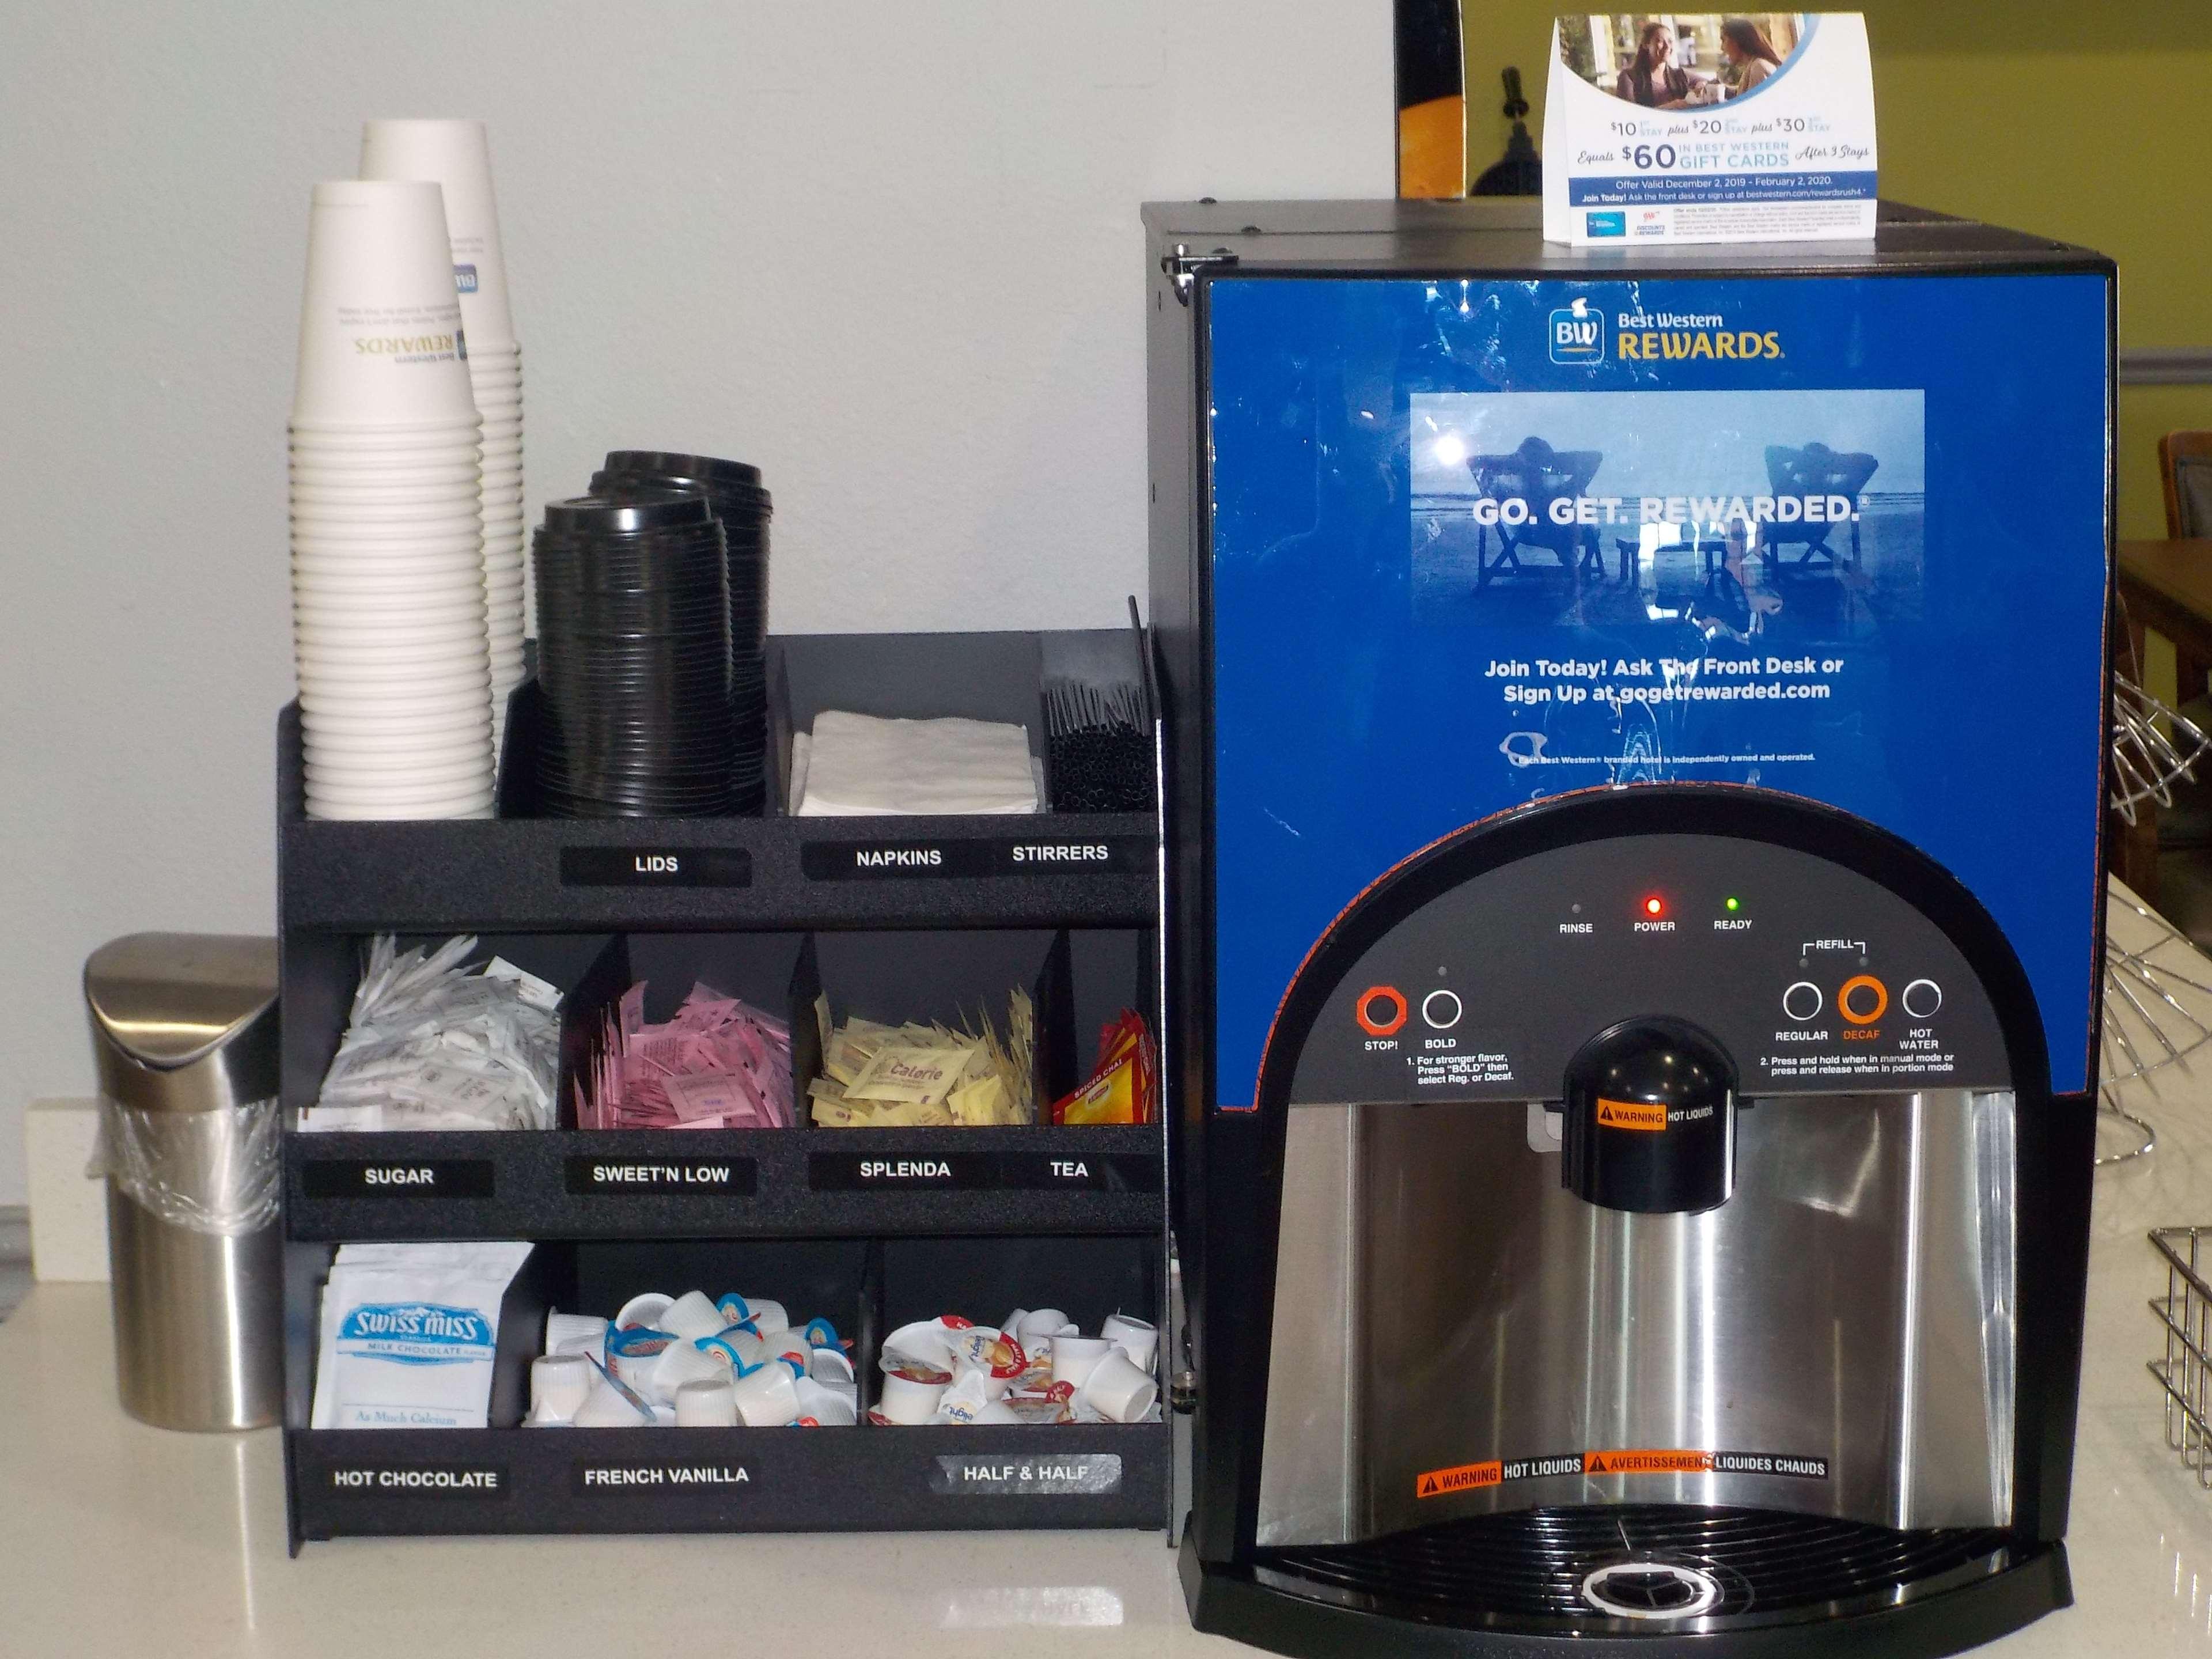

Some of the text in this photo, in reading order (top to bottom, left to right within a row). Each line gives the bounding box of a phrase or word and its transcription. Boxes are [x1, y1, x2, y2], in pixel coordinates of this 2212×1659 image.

[1611, 122, 1637, 136] $10
[1668, 124, 1689, 137] plus
[1692, 120, 1722, 134] $20
[1751, 122, 1772, 135] plus
[1776, 118, 1805, 132] $30
[1679, 142, 1789, 153] IN BEST WESTERN
[1796, 146, 1827, 160] After
[1838, 144, 1869, 160] Stays
[1578, 144, 1676, 169] Equals $60
[1680, 154, 1789, 169] GIFT CARDS
[1616, 181, 1639, 190] Offer
[1642, 180, 1664, 190] Valid
[1666, 179, 1711, 189] December
[1714, 179, 1722, 188] 2,
[1725, 178, 1746, 187] 2019
[1755, 177, 1796, 187] February
[1798, 177, 1806, 186] 2,
[1582, 194, 1599, 202] Join
[1601, 194, 1627, 203] Today!
[1628, 193, 1642, 201] Ask
[1658, 192, 1677, 200] front
[1679, 191, 1695, 200] desk
[1707, 191, 1724, 201] sign
[1618, 313, 1724, 328] Best Western
[1556, 321, 1598, 345] BW
[1472, 498, 1538, 525] GO.
[1548, 497, 1628, 524] GET.
[1484, 657, 1844, 679] Join Today! Ask The Front Desk or
[1503, 682, 1830, 705] Sign Up at gogetrewarded.com
[1540, 756, 1560, 764] Best
[1604, 755, 1638, 764] branded
[1640, 755, 1662, 764] hotel
[1664, 755, 1671, 764] is
[1672, 754, 1729, 764] independently
[1731, 754, 1758, 762] owned
[1760, 753, 1775, 762] and
[1777, 753, 1816, 763] operated.
[857, 849, 942, 867] NAPKINS
[1012, 844, 1108, 862] STIRRERS
[635, 856, 678, 872] LIDS
[1559, 923, 1593, 934] RINSE
[1634, 922, 1675, 931] POWER
[1714, 919, 1752, 930] READY
[1816, 940, 1854, 949] REFILL
[1775, 1031, 1829, 1041] REGULAR
[1843, 1029, 1881, 1040] DECAF
[1909, 1028, 1933, 1038] HOT
[1364, 1040, 1399, 1051] STOP!
[1425, 1039, 1457, 1049] BOLD
[1899, 1039, 1939, 1050] WATER
[1406, 1053, 1508, 1066] 1. For stronger flavor,
[1760, 1058, 1768, 1066] 2.
[1771, 1056, 1798, 1066] Press
[1800, 1056, 1817, 1065] and
[1820, 1055, 1840, 1064] hold
[1842, 1055, 1867, 1064] when
[1869, 1055, 1877, 1063] in
[1880, 1054, 1914, 1063] manual
[1916, 1053, 1942, 1062] mode
[891, 1062, 944, 1081] Calorie
[1418, 1066, 1445, 1075] Press
[1487, 1062, 1509, 1071] then
[1771, 1063, 1954, 1077] press and release when in portion mode
[1074, 1077, 1101, 1099] SPICED
[1103, 1058, 1123, 1078] CHAI
[1418, 1075, 1446, 1085] select
[1448, 1074, 1469, 1085] Reg.
[1484, 1071, 1514, 1082] Decaf.
[1615, 1105, 1713, 1123] WARNING HOT LIQUIDS
[365, 1168, 435, 1184] SUGAR
[685, 1166, 729, 1183] LOW
[860, 1162, 951, 1177] SPLENDA
[1051, 1161, 1088, 1177] TEA
[367, 1342, 393, 1351] MILK
[397, 1344, 461, 1355] CHOCOLATE
[334, 1471, 497, 1487] HOT CHOCOLATE
[585, 1467, 749, 1485] FRENCH VANILLA
[964, 1465, 1089, 1480] HALF & HALF
[1442, 1455, 1825, 1488] WARNING HOT LIQUIDS AVERTISSEMEN LIQUIDES CHAUDS
